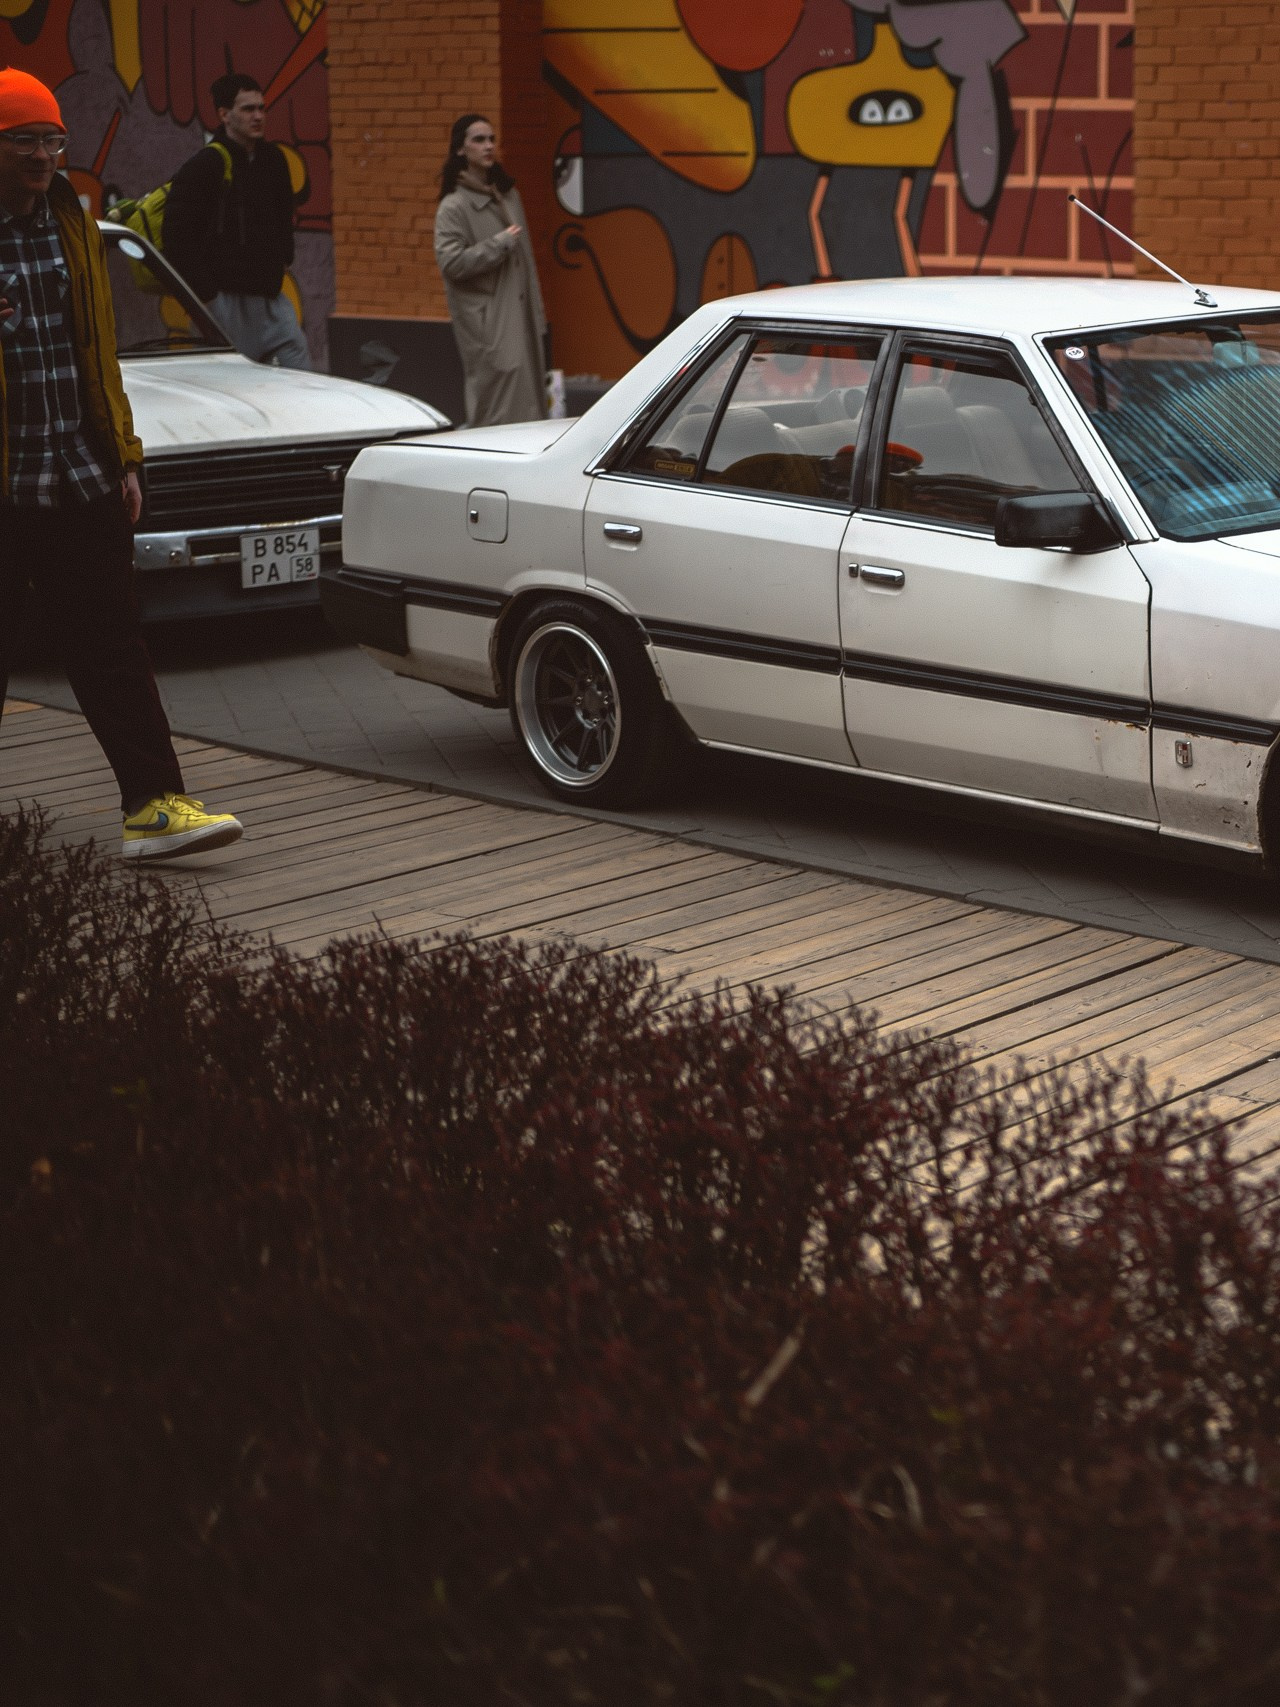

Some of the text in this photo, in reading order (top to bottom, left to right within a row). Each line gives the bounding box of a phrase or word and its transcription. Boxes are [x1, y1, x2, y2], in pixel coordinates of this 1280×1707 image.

[274, 533, 308, 555] 854
[251, 557, 313, 584] РА 58
